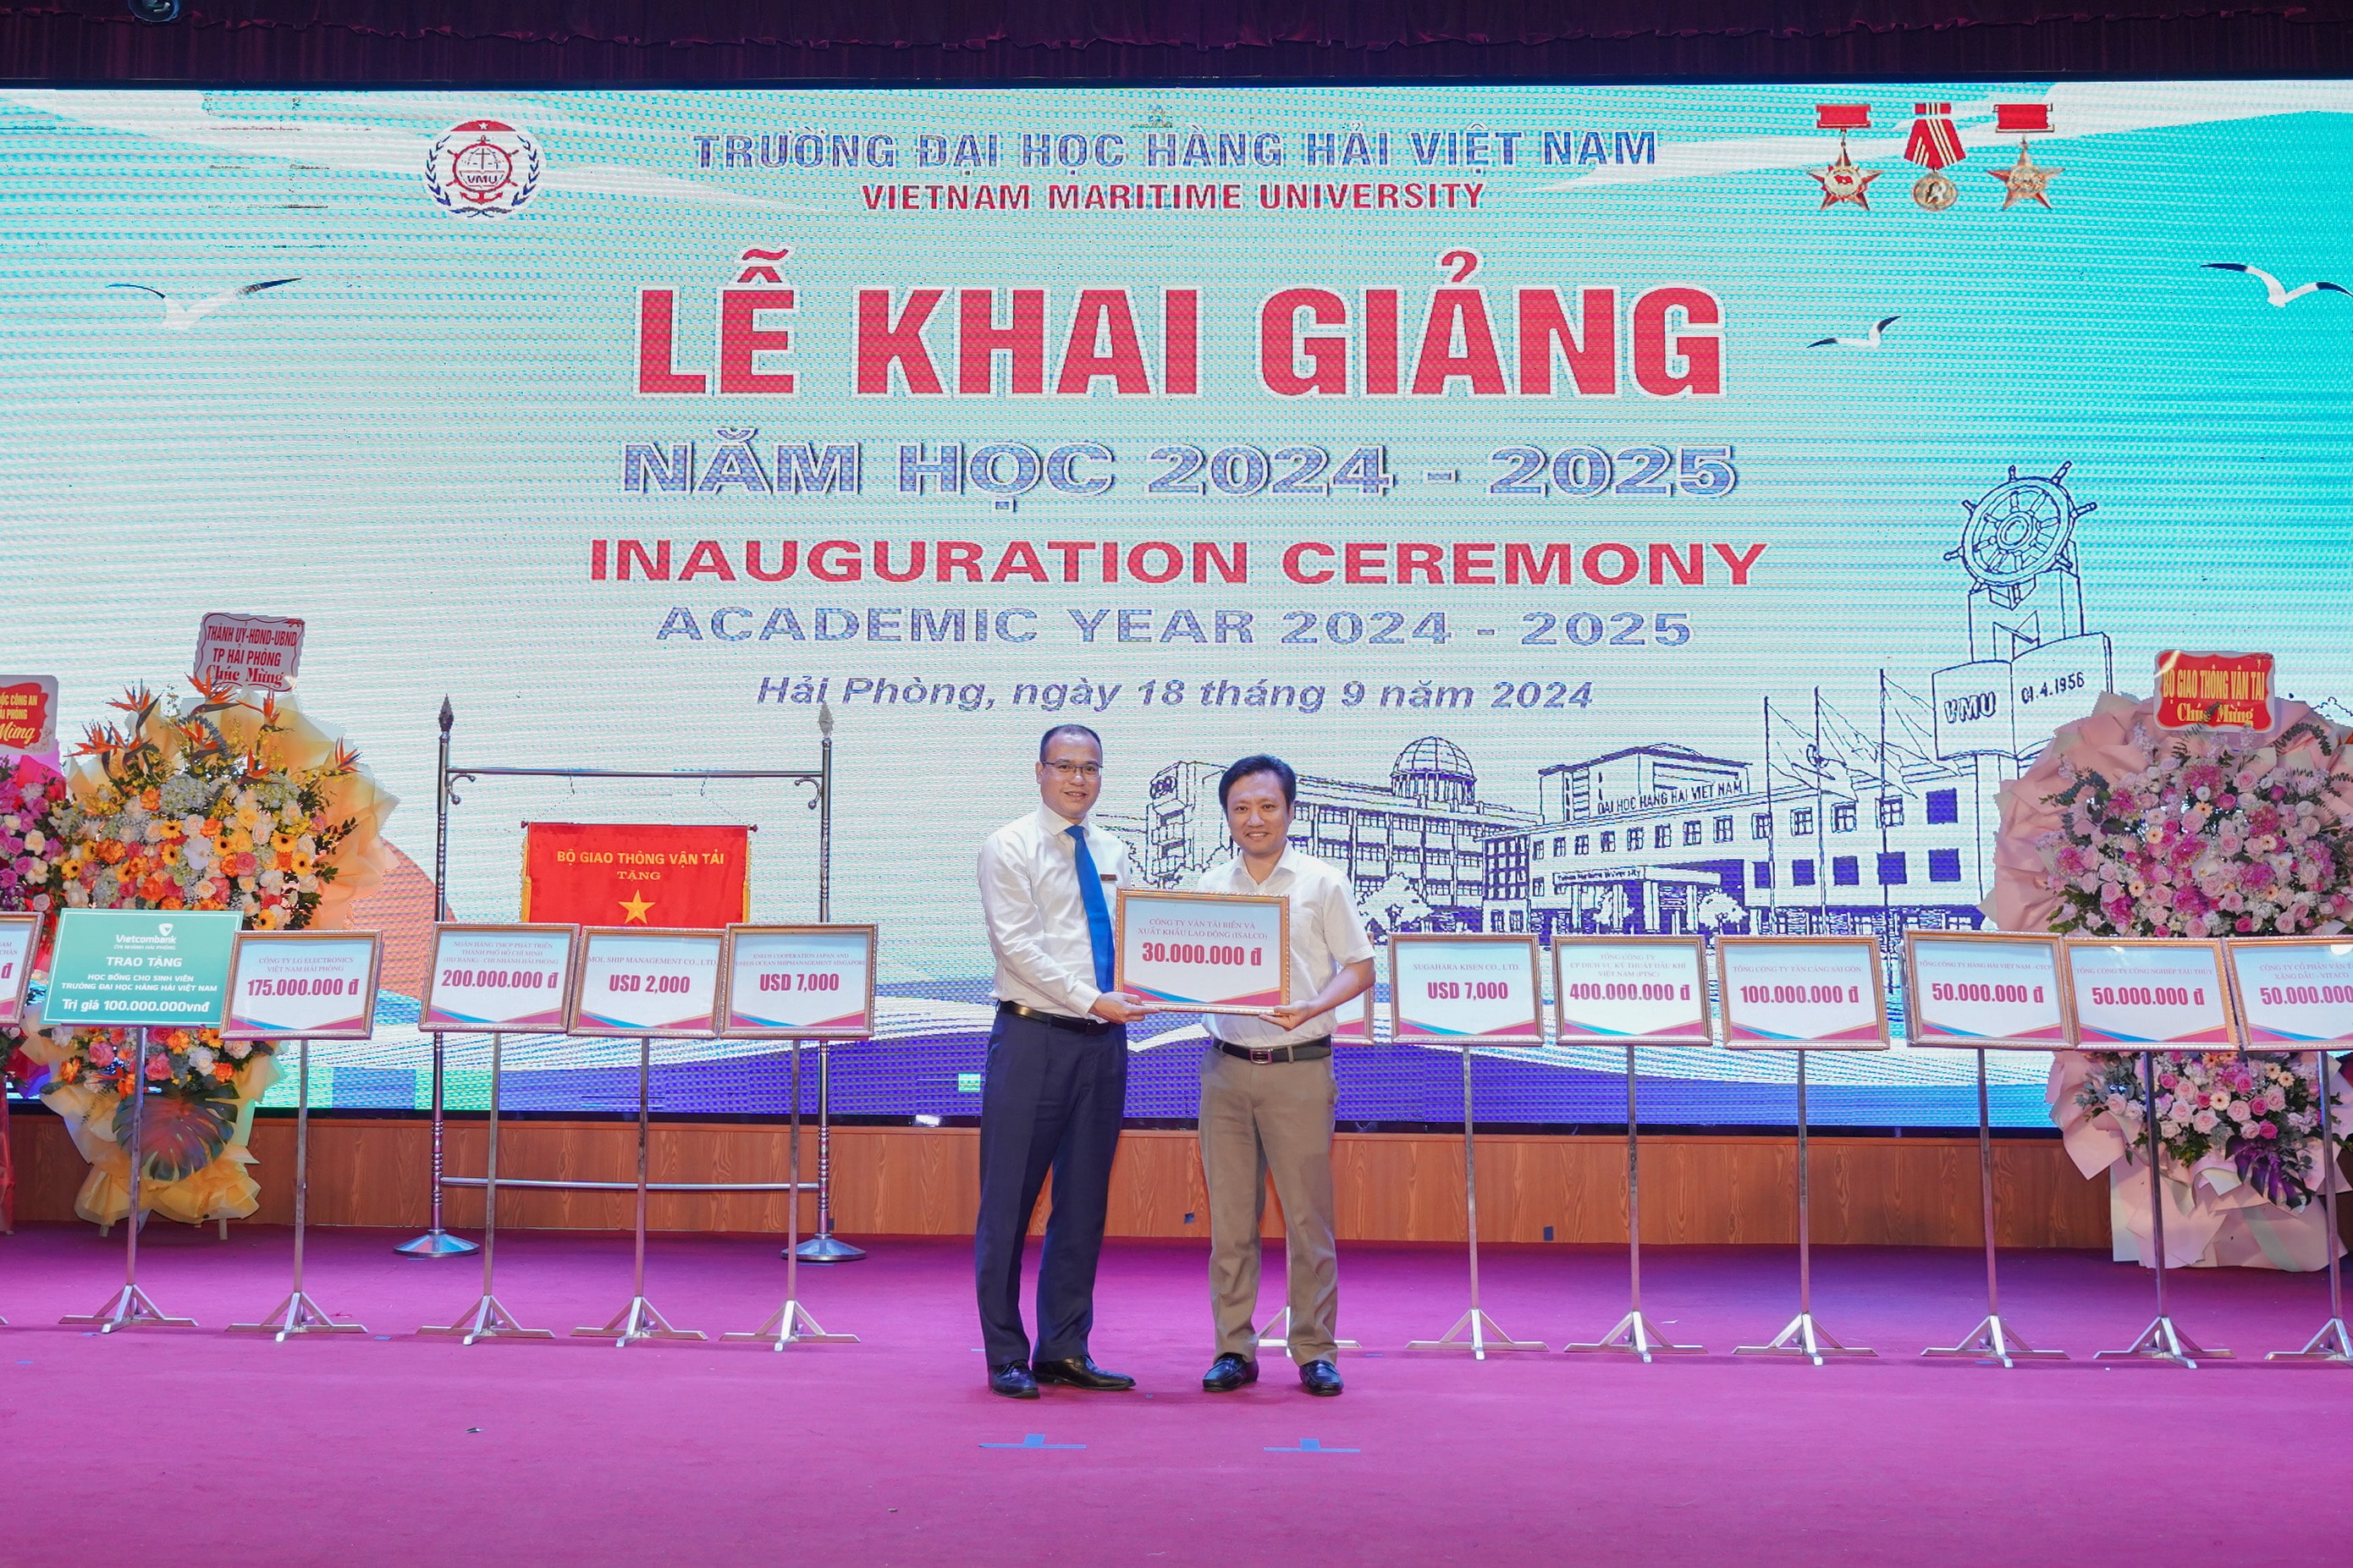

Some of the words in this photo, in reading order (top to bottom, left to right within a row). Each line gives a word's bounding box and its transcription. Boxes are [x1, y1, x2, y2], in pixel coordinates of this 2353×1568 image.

[693, 126, 895, 168] TRƯỜNG
[915, 133, 998, 175] ĐẠI
[1022, 133, 1125, 175] HỌC
[1148, 125, 1282, 167] HÀNG
[1307, 123, 1387, 167] HẢI
[1411, 124, 1522, 173] VIỆT
[1544, 131, 1656, 166] NAM
[467, 175, 498, 184] VMU
[862, 185, 1030, 211] VIETNAM
[1050, 184, 1240, 210] MARITIME
[1260, 183, 1484, 209] UNIVERSITY
[639, 249, 794, 394] LỄ
[857, 289, 1197, 394] KHAI
[1261, 250, 1721, 395] GIẢNG
[622, 426, 862, 494] NĂM
[899, 441, 1115, 511] HỌC
[1147, 445, 1396, 498] 2024
[1489, 445, 1738, 498] 2025
[592, 539, 1248, 583] INAUGURATION
[1282, 542, 1767, 585] CEREMONY
[207, 623, 234, 641] THÀNH
[657, 607, 1038, 642] ACADEMIC
[1067, 608, 1254, 644] YEAR
[1281, 611, 1452, 646] 2024
[1522, 611, 1691, 646] 2025
[213, 648, 224, 663] TP
[227, 644, 243, 664] HẢI
[246, 648, 281, 667] PHÒNG
[245, 668, 284, 688] Mừng
[2163, 669, 2175, 704] BỘ
[2177, 669, 2197, 698] GIAO
[2200, 664, 2228, 700] THÔNG
[2231, 665, 2248, 707] VẬN
[2251, 659, 2265, 701] TẢI
[758, 676, 828, 705] Hải
[842, 676, 995, 711] Phòng,
[1012, 677, 1121, 712] ngày
[1138, 679, 1184, 706] 18
[1201, 679, 1325, 712] tháng
[1342, 681, 1364, 707] 9
[1380, 679, 1474, 708] năm
[1492, 681, 1593, 708] 2024
[1944, 691, 1996, 723] VMU
[557, 849, 576, 866] BỘ
[580, 852, 613, 864] GIAO
[617, 850, 664, 865] THÔNG
[670, 850, 698, 868] VẬN
[702, 850, 725, 865] TẢI
[617, 871, 662, 881] TẶNG
[116, 934, 176, 944] Vietcombank
[106, 956, 143, 966] TRAO
[147, 955, 183, 968] TẶNG
[1142, 942, 1244, 966] 30.000.000
[1250, 947, 1262, 966] đ
[178, 983, 196, 992] VIỆT
[247, 978, 344, 996] 175.000.000
[348, 978, 360, 995] đ
[442, 970, 543, 988] 200.000.000
[548, 972, 559, 988] đ
[609, 975, 641, 992] USD
[645, 975, 691, 994] 2,000
[759, 974, 791, 991] USD
[796, 974, 840, 993] 7,000
[1427, 982, 1460, 999] USD
[1464, 982, 1508, 1001] 7,000
[1570, 983, 1674, 1000] 400.000.000
[1680, 984, 1690, 1000] đ
[1740, 985, 1843, 1004] 100.000.000
[1849, 986, 1860, 1004] đ
[1931, 983, 2028, 1003] 50.000.000
[2033, 986, 2044, 1004] đ
[2091, 987, 2189, 1005] 50.000.000
[2193, 988, 2205, 1005] đ
[2260, 985, 2353, 1004] 50.000.000
[62, 999, 78, 1012] Trị
[80, 999, 99, 1012] giá
[103, 1000, 210, 1013] 100.000.000vnđ
